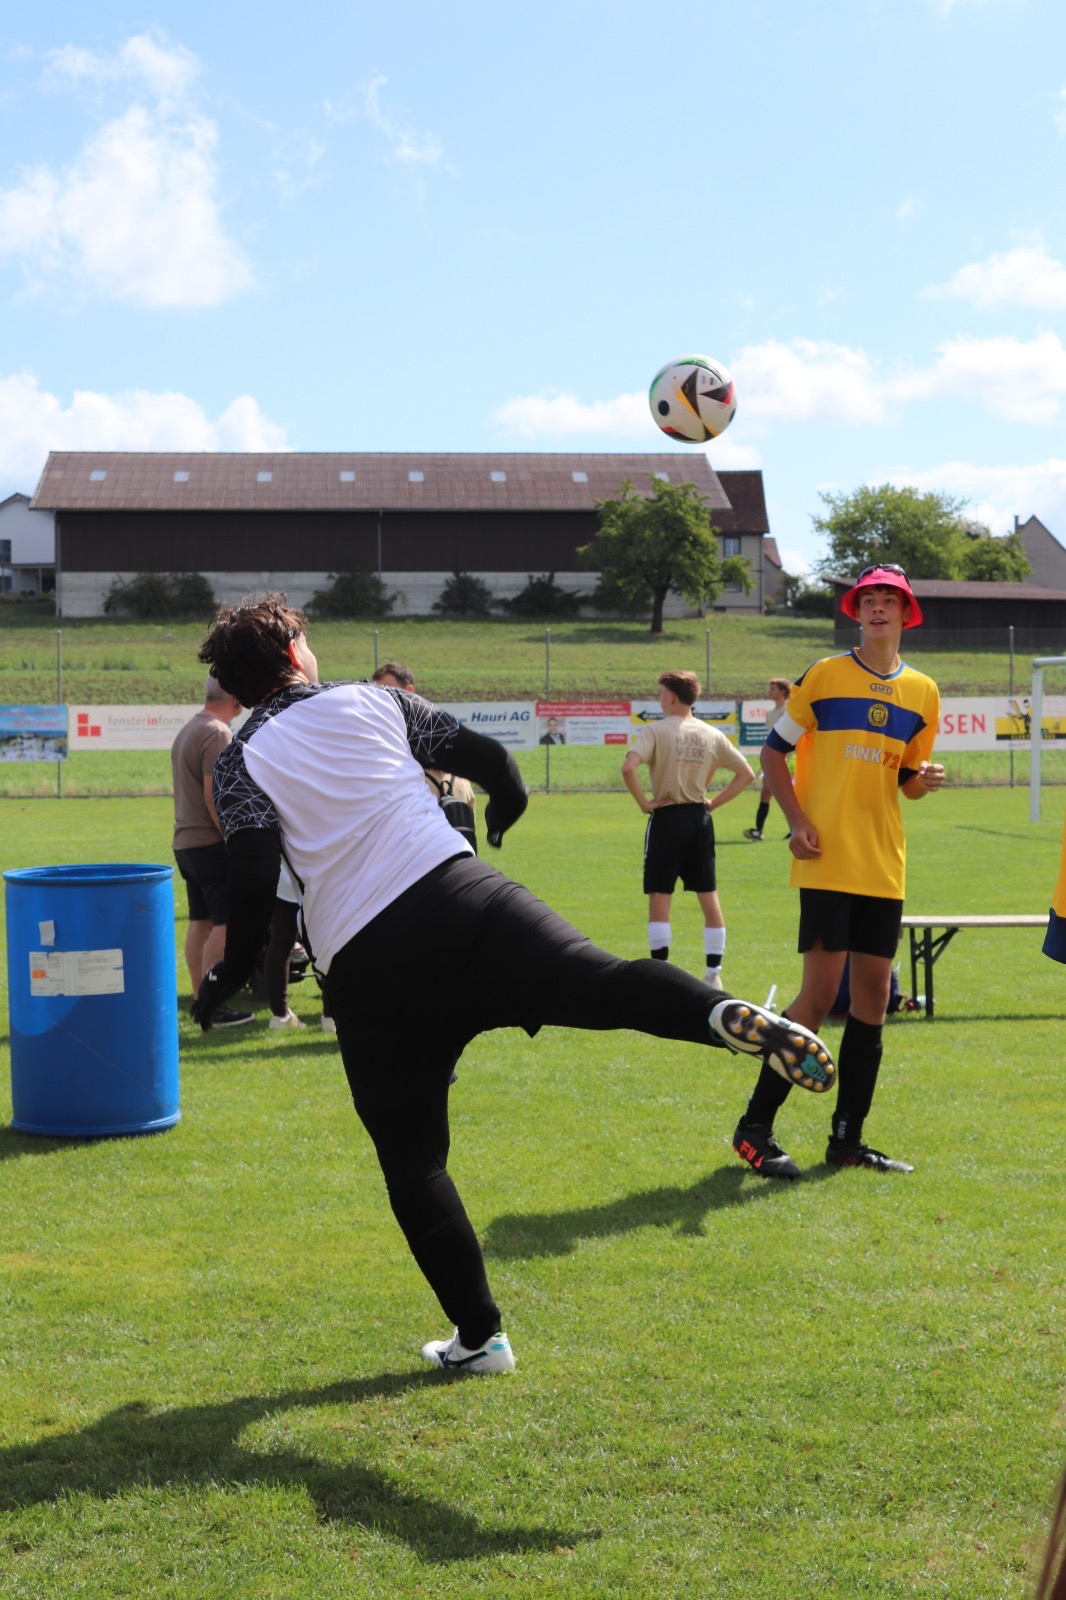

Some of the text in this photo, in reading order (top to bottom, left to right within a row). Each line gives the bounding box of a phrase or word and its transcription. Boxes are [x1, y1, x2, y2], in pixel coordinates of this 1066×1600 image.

[108, 714, 185, 727] fensterinform
[471, 711, 508, 723] Hauri
[509, 711, 531, 723] AG
[675, 735, 707, 747] HAND
